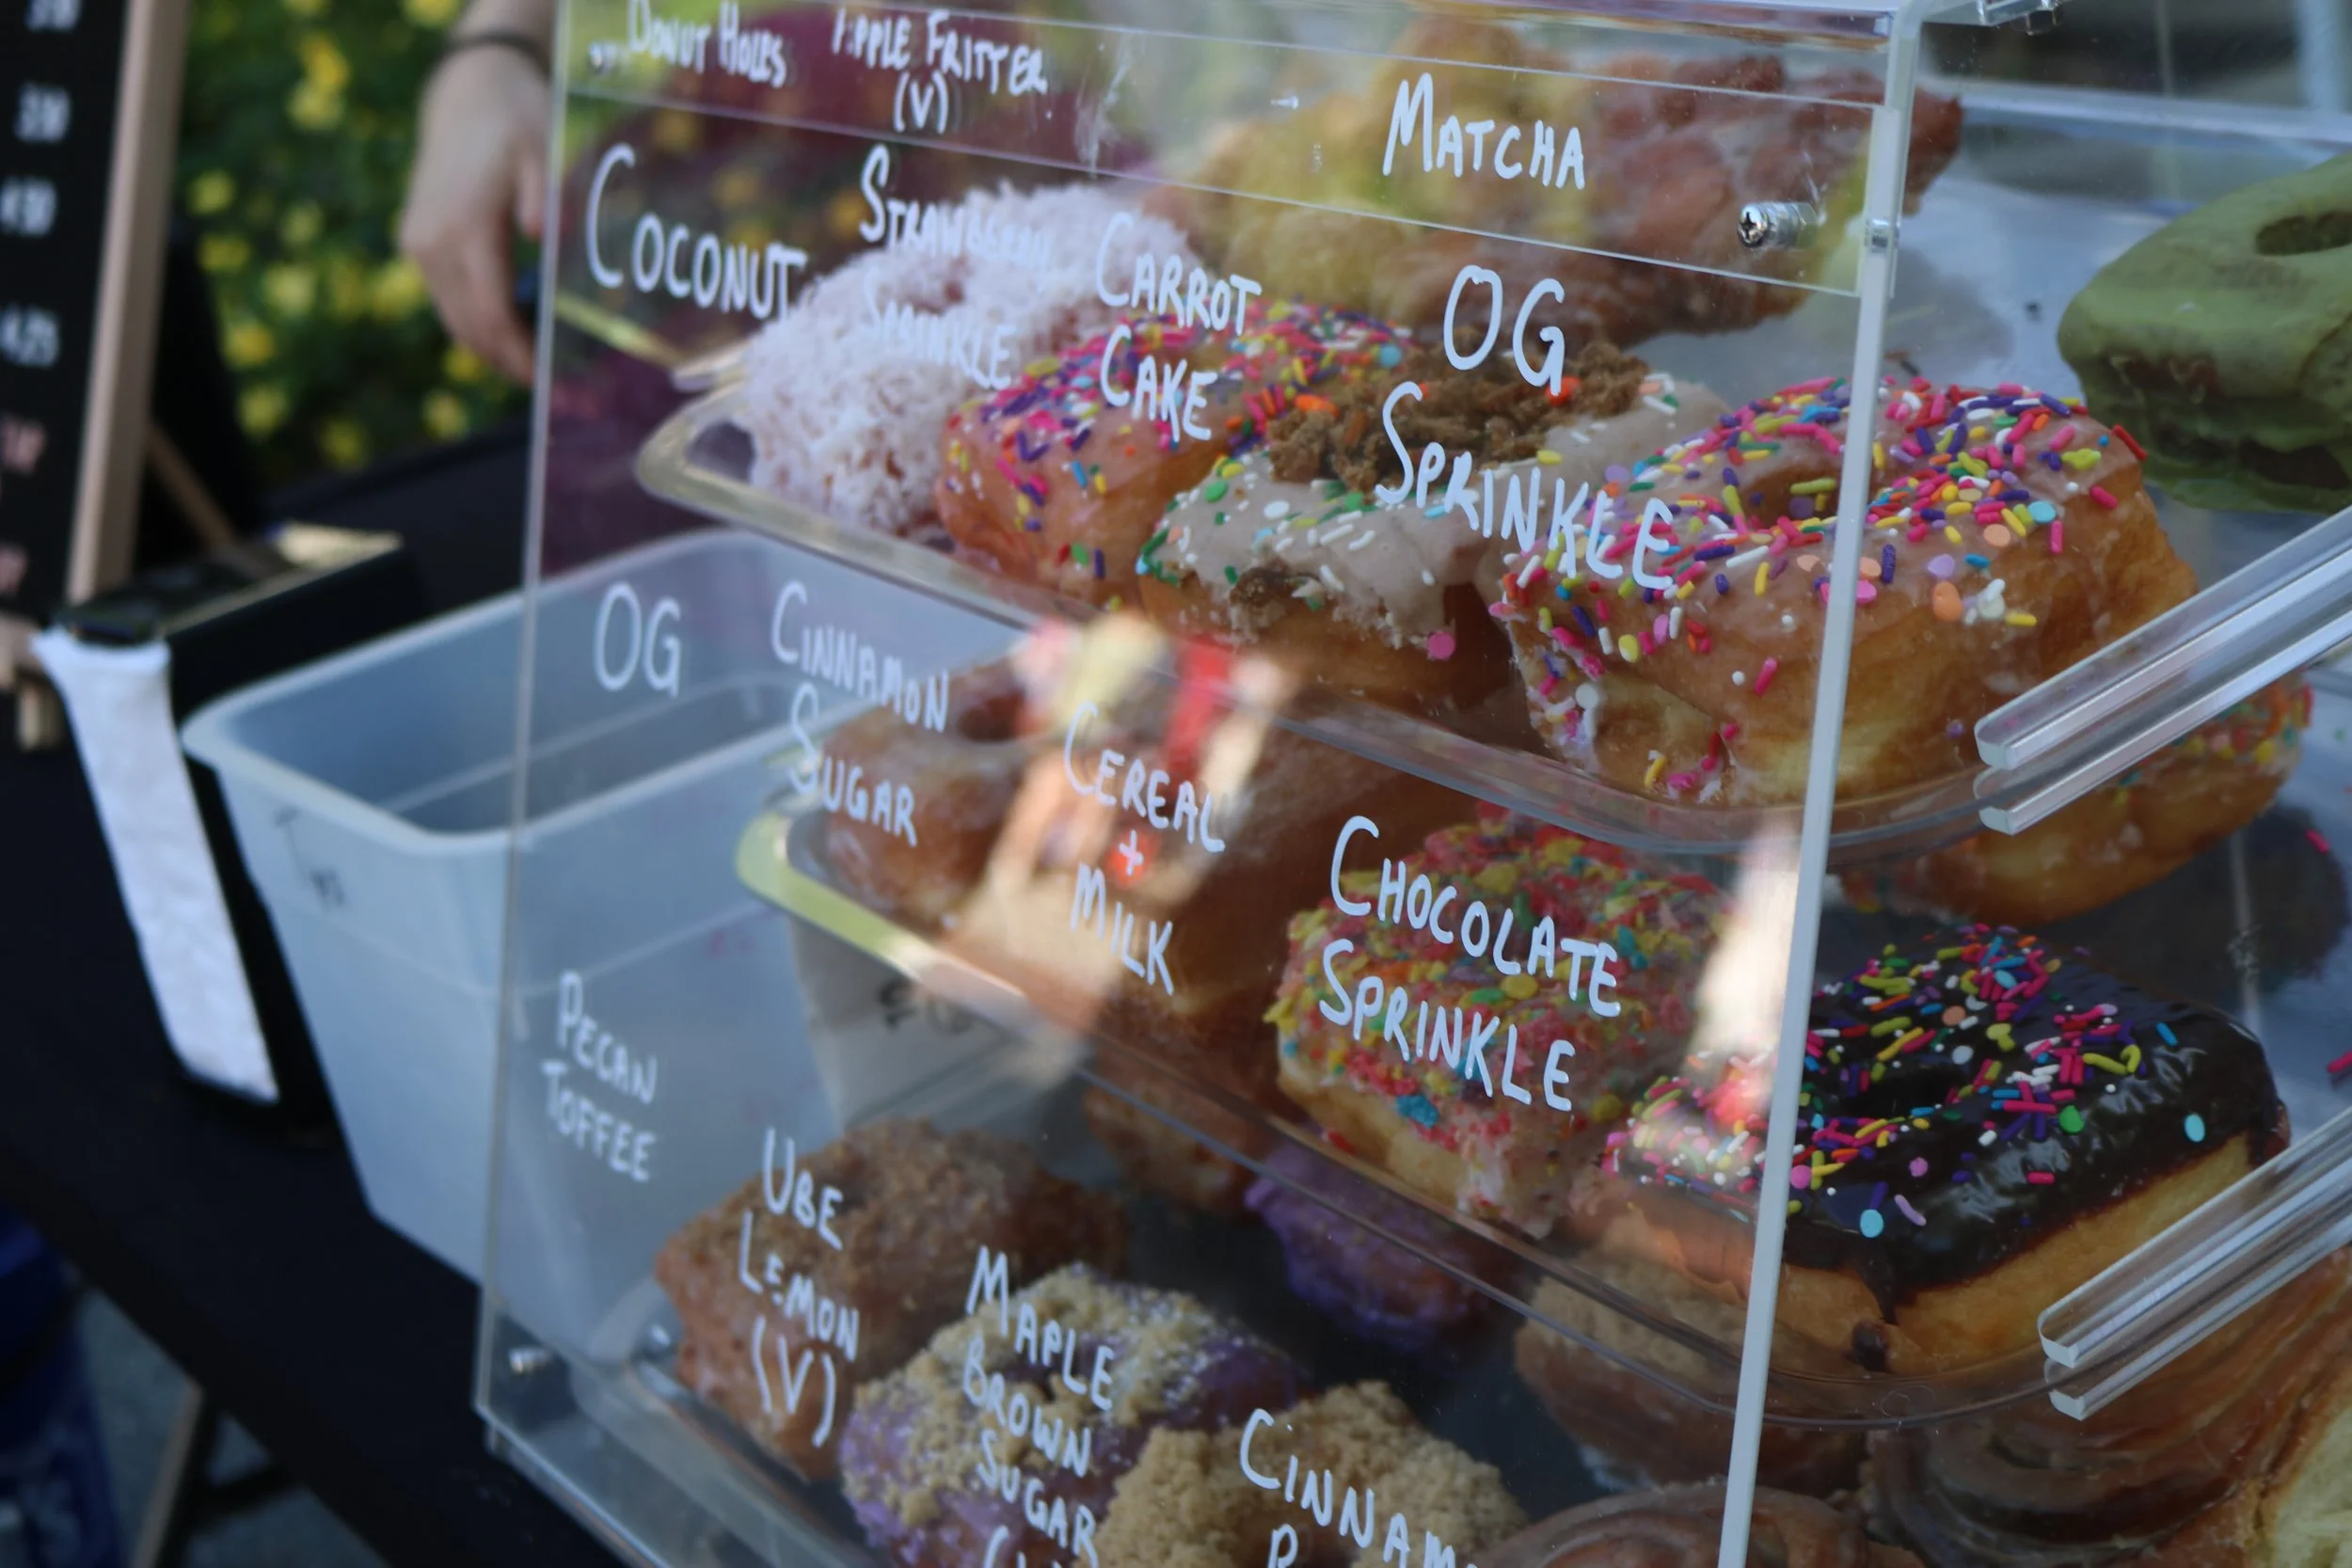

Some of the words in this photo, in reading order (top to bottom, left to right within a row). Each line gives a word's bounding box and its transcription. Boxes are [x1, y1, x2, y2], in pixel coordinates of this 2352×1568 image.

[895, 70, 949, 134] (V)
[926, 9, 1049, 96] FRITTER
[1383, 72, 1586, 190] MATCHA
[585, 143, 807, 320] COCONUT
[1096, 213, 1263, 336] CARROT
[1099, 325, 1219, 443] CAKE
[1443, 265, 1566, 396] OG
[1375, 382, 1675, 590] SPRINKLE
[593, 582, 683, 698] OG
[771, 579, 951, 733] CINNAMON
[788, 683, 917, 846] SUGAR
[1063, 702, 1227, 853] CEREAL
[1070, 862, 1175, 995] MILK
[1329, 815, 1622, 1018] CHOCOLATE
[556, 970, 658, 1104] PECAN
[1319, 939, 1577, 1112] SPRINKLE
[541, 1058, 656, 1182] TOFFEE
[762, 1127, 844, 1250] UBE
[739, 1212, 860, 1362] LEMON
[964, 1245, 1115, 1411] MAPLE
[754, 1316, 837, 1449] (V)
[962, 1330, 1091, 1478] BROWN
[975, 1429, 1100, 1568] SUGAR
[1239, 1407, 1479, 1568] CINNAM
